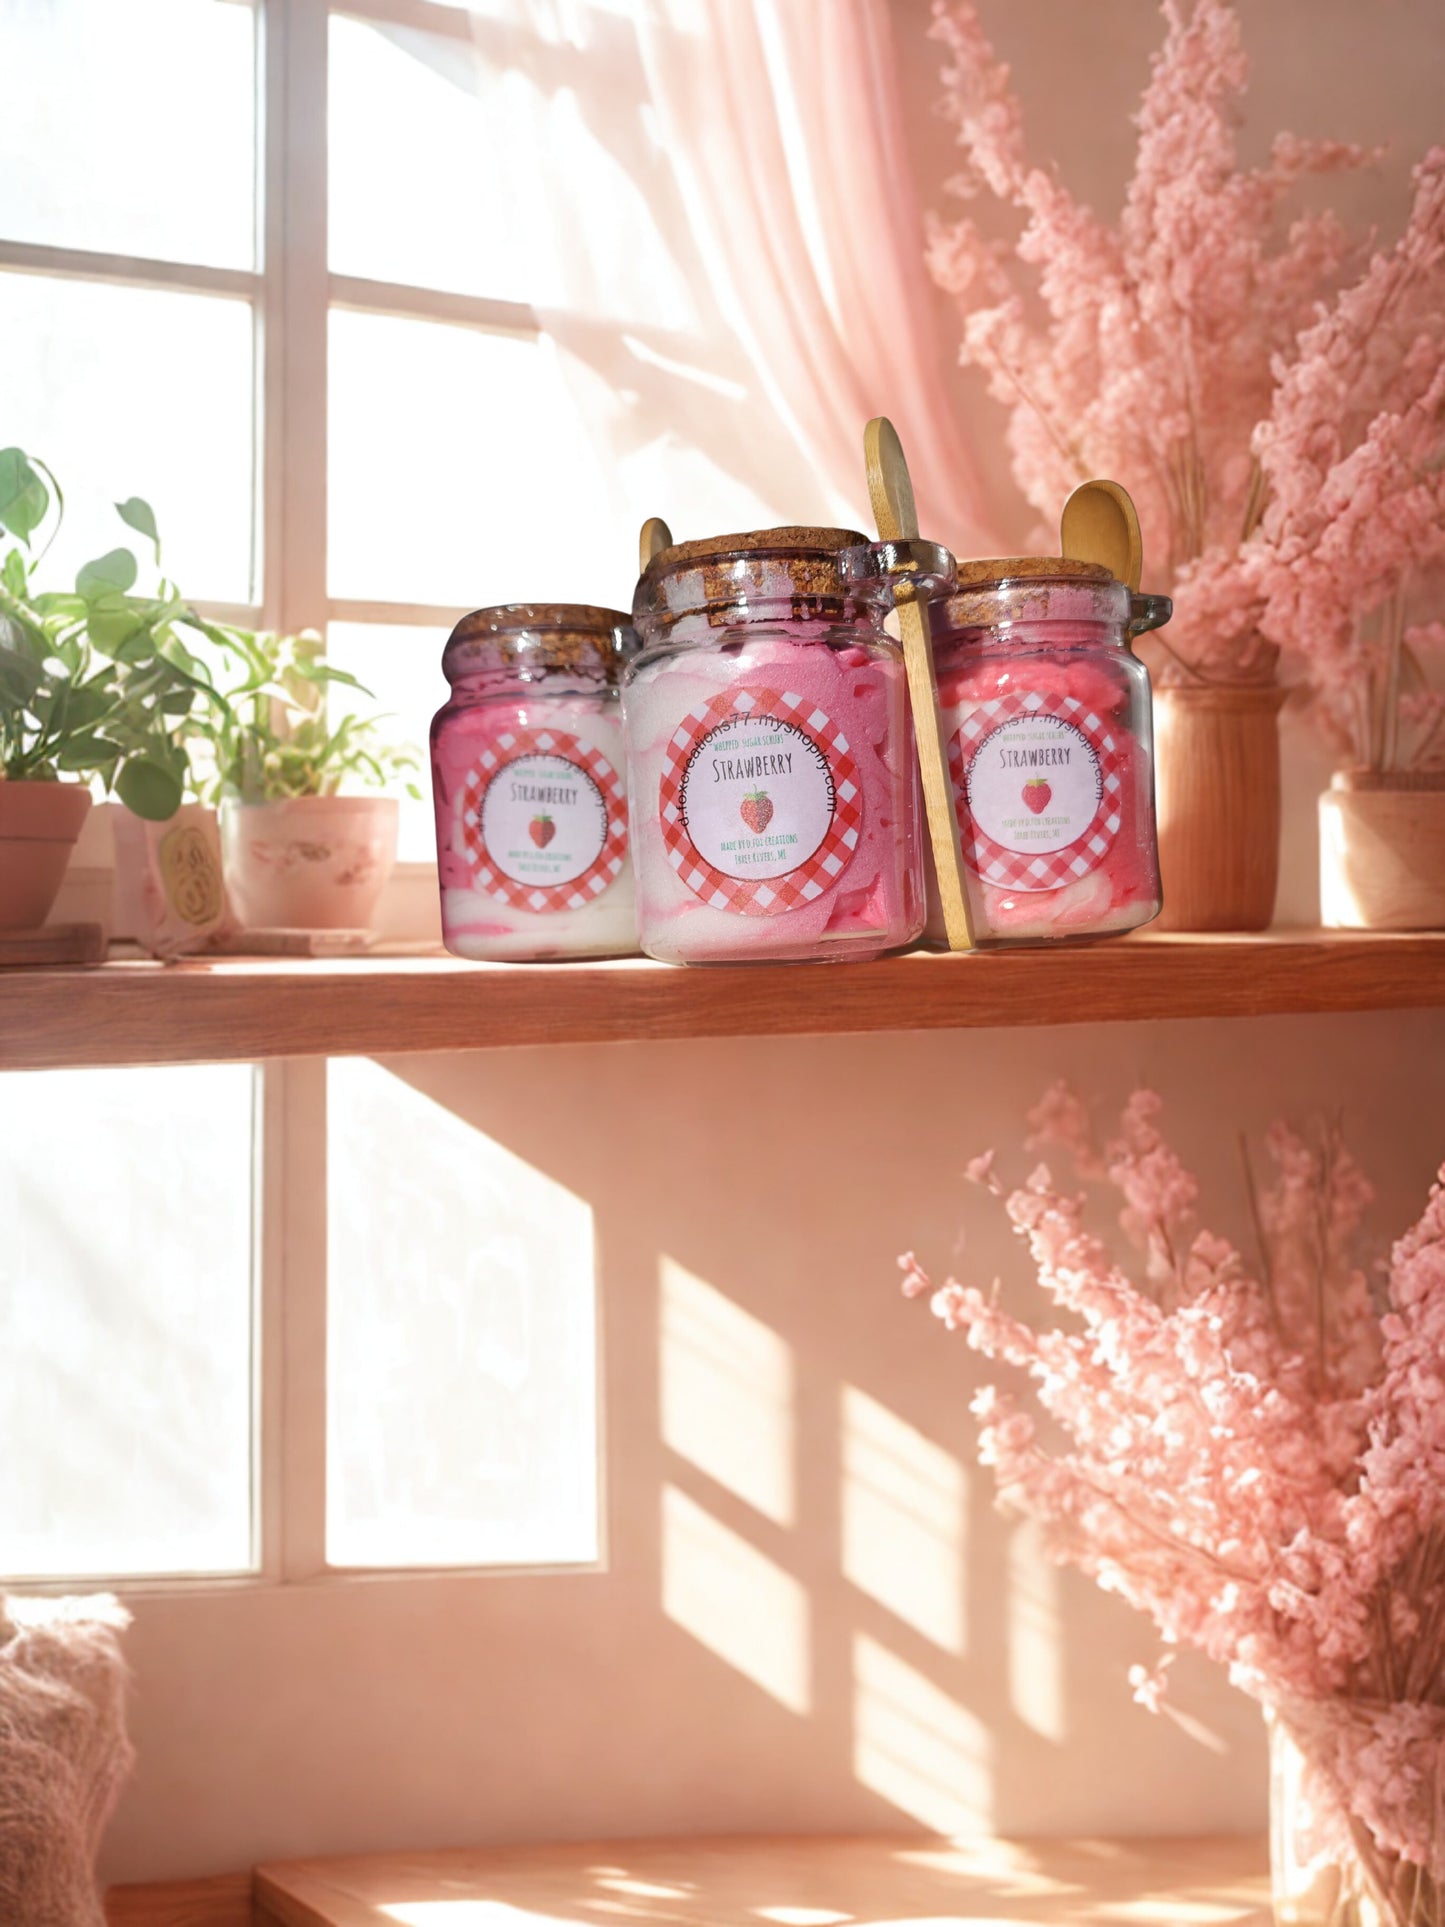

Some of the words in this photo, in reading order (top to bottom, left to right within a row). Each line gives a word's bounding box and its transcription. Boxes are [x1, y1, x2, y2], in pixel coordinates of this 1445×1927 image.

[676, 711, 838, 827] d.foxcreations77.myshopify.com
[712, 753, 793, 783] STRAWBERRY
[999, 747, 1071, 769] STRAWBERRY
[511, 782, 578, 805] STRAWBERRY
[764, 833, 799, 847] CREATIONS
